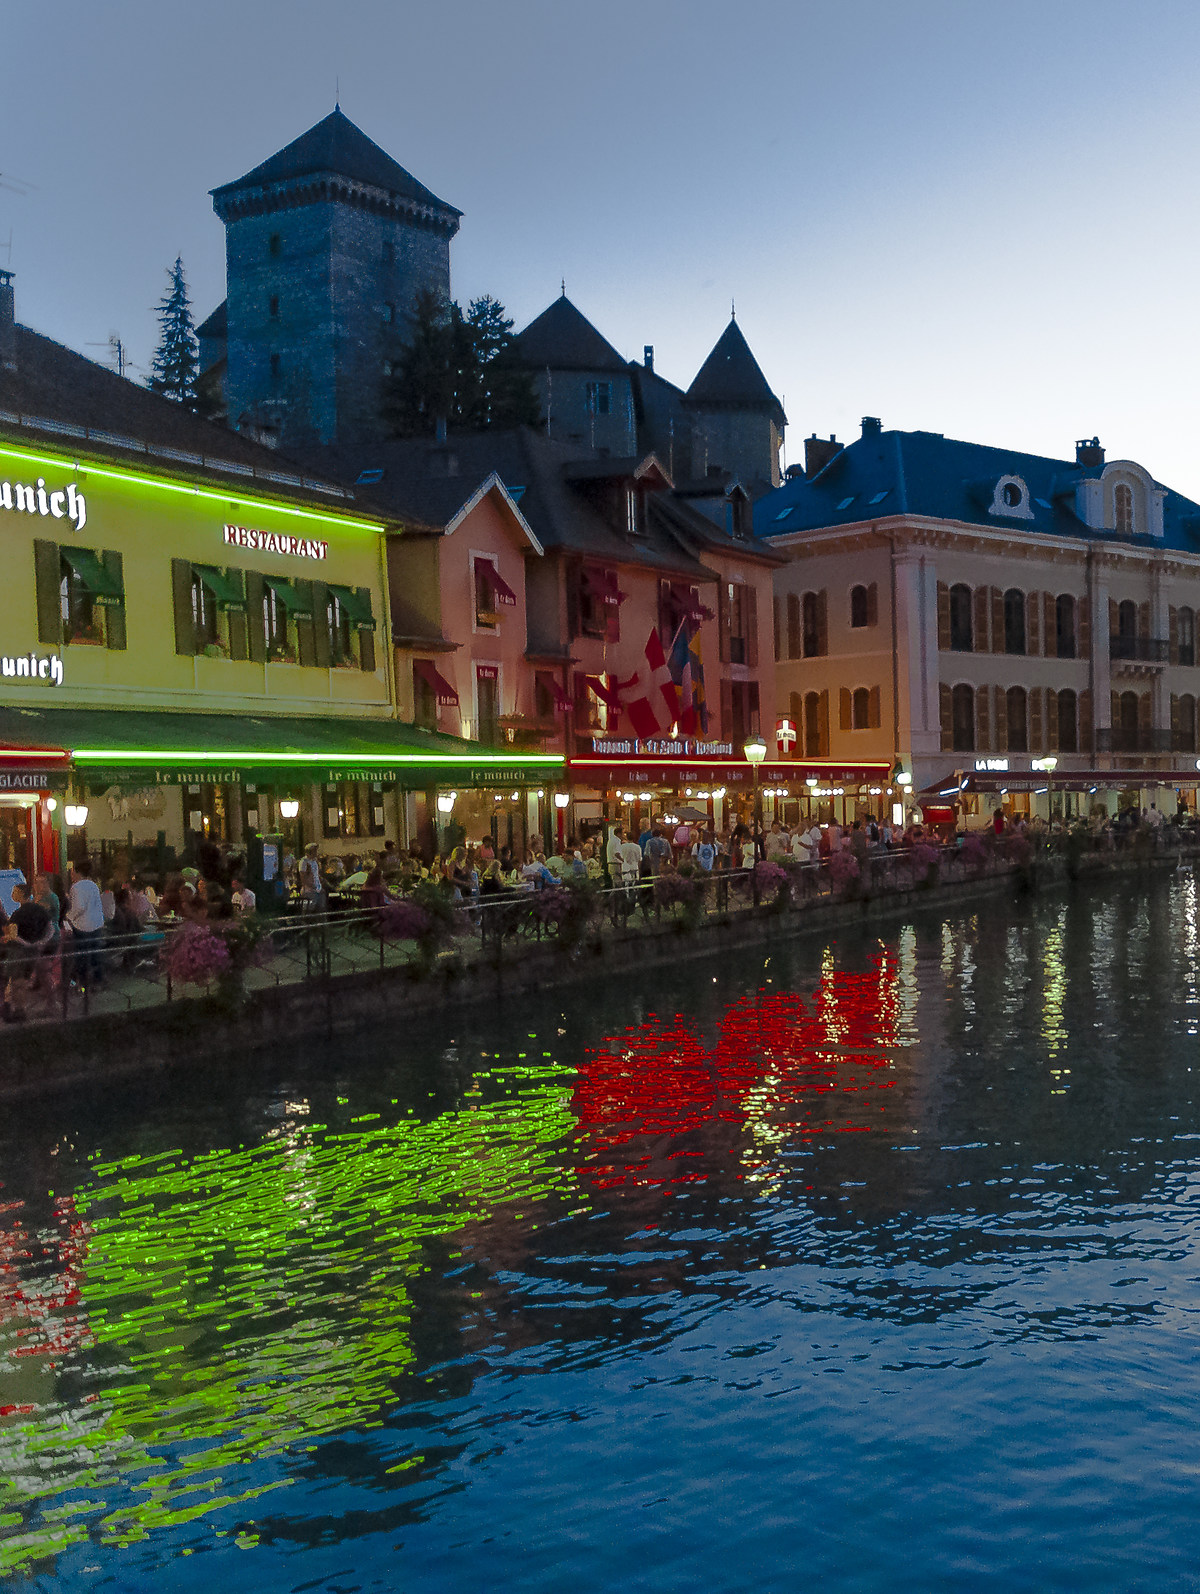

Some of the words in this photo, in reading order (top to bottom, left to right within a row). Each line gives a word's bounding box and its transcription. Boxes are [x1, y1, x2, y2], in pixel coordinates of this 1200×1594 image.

[223, 523, 329, 560] RESTAURANT
[2, 652, 64, 686] unich
[0, 774, 48, 787] GLACIER
